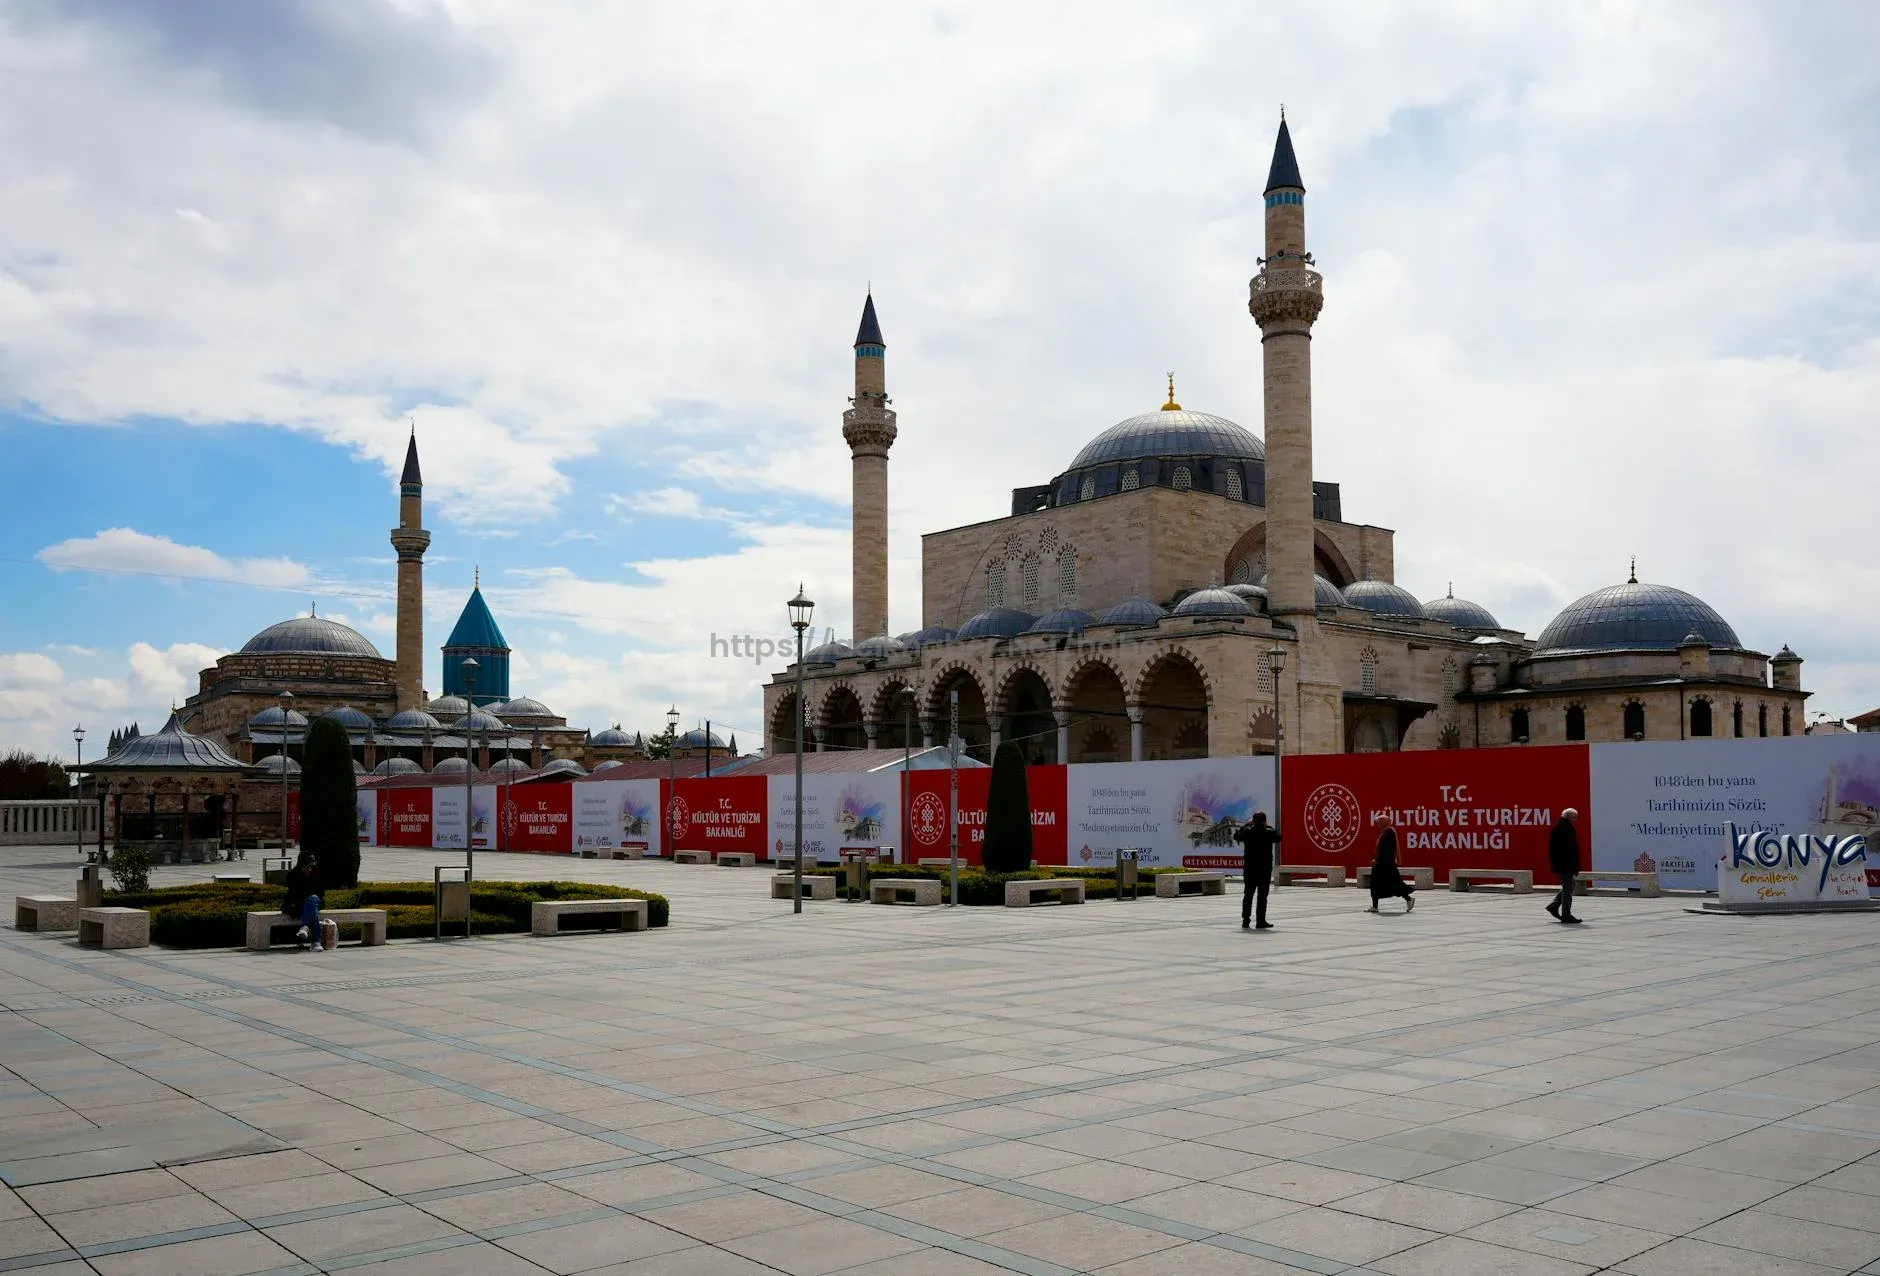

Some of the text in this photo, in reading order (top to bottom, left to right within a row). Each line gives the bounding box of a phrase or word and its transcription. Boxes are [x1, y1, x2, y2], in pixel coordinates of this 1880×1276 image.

[1655, 774, 1757, 790] 1048’den bu yana
[1440, 785, 1473, 802] T.C.
[719, 798, 732, 809] T.C.
[1646, 798, 1767, 812] Tarihimizin Sözü;
[692, 811, 760, 824] KÜLTÜR VE TURİZM
[1370, 804, 1551, 827] KÜLTÜR VE TURİZM
[706, 825, 745, 838] BAKANLIĞI
[1406, 828, 1510, 850] BAKANLIĞI
[1630, 822, 1747, 840] “Medeniyetimin
